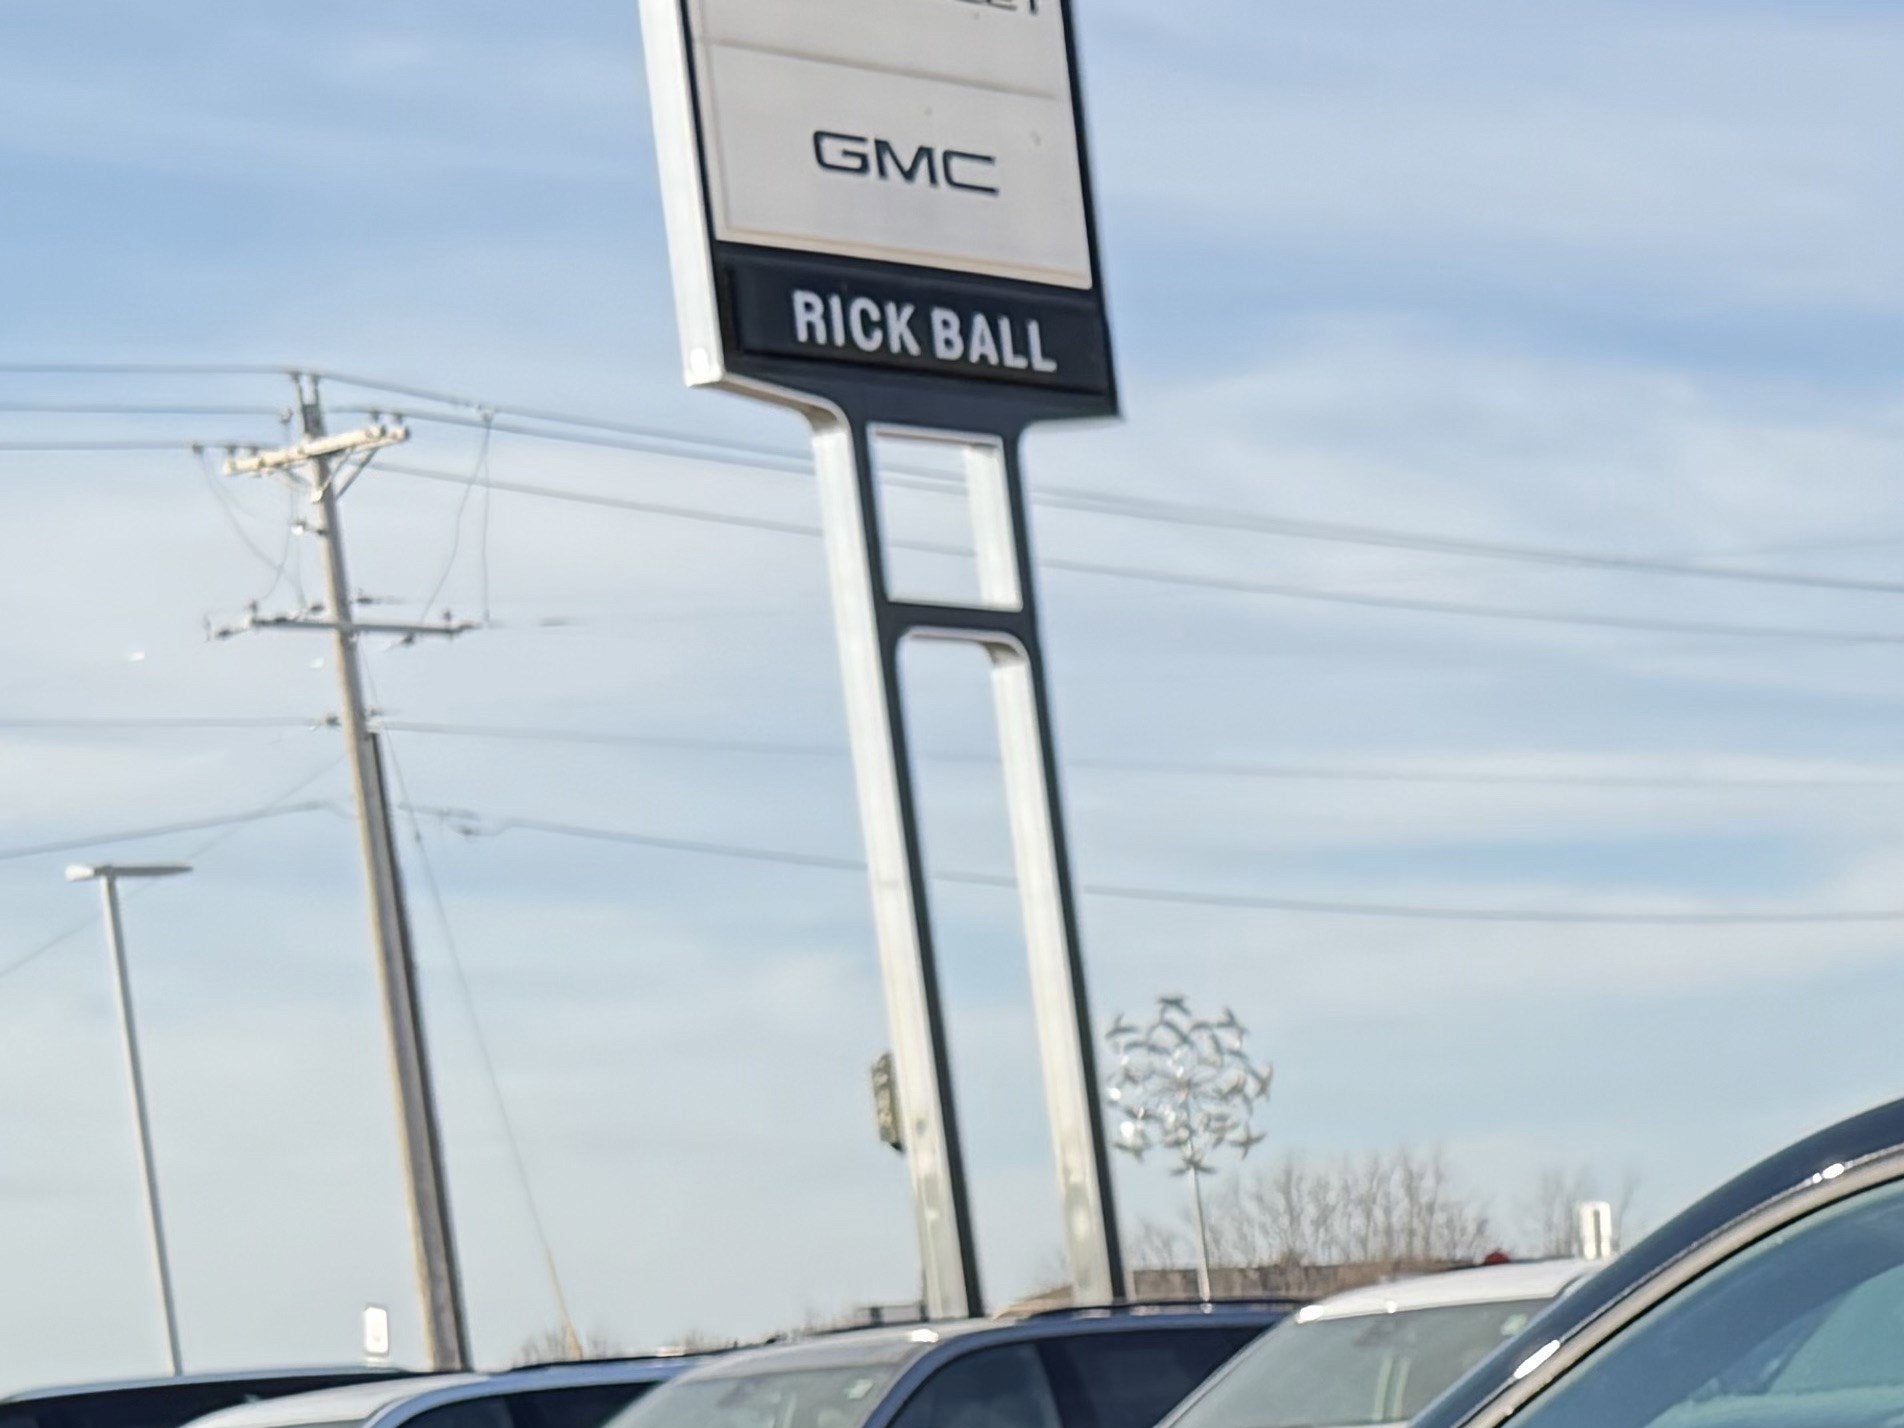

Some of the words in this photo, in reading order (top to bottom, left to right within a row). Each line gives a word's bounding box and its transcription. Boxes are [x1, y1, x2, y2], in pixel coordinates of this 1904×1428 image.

[812, 129, 999, 197] GMC
[792, 289, 922, 357] RICK
[930, 306, 1058, 374] BALL
